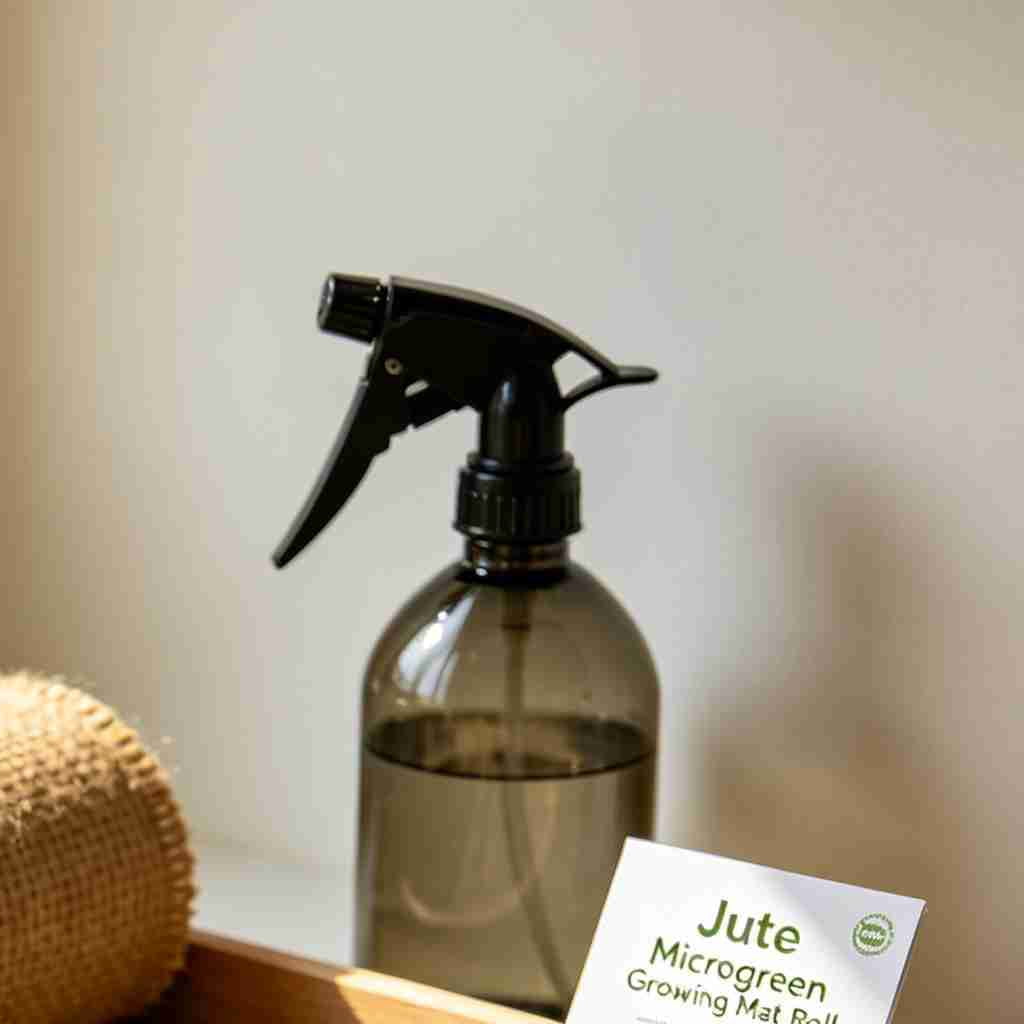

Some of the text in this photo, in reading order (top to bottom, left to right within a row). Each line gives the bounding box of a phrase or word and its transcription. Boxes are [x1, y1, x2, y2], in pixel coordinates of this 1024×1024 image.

[697, 899, 801, 954] Jute
[627, 968, 728, 1017] Growing
[736, 995, 781, 1024] Mat
[649, 936, 826, 1002] Microgreen
